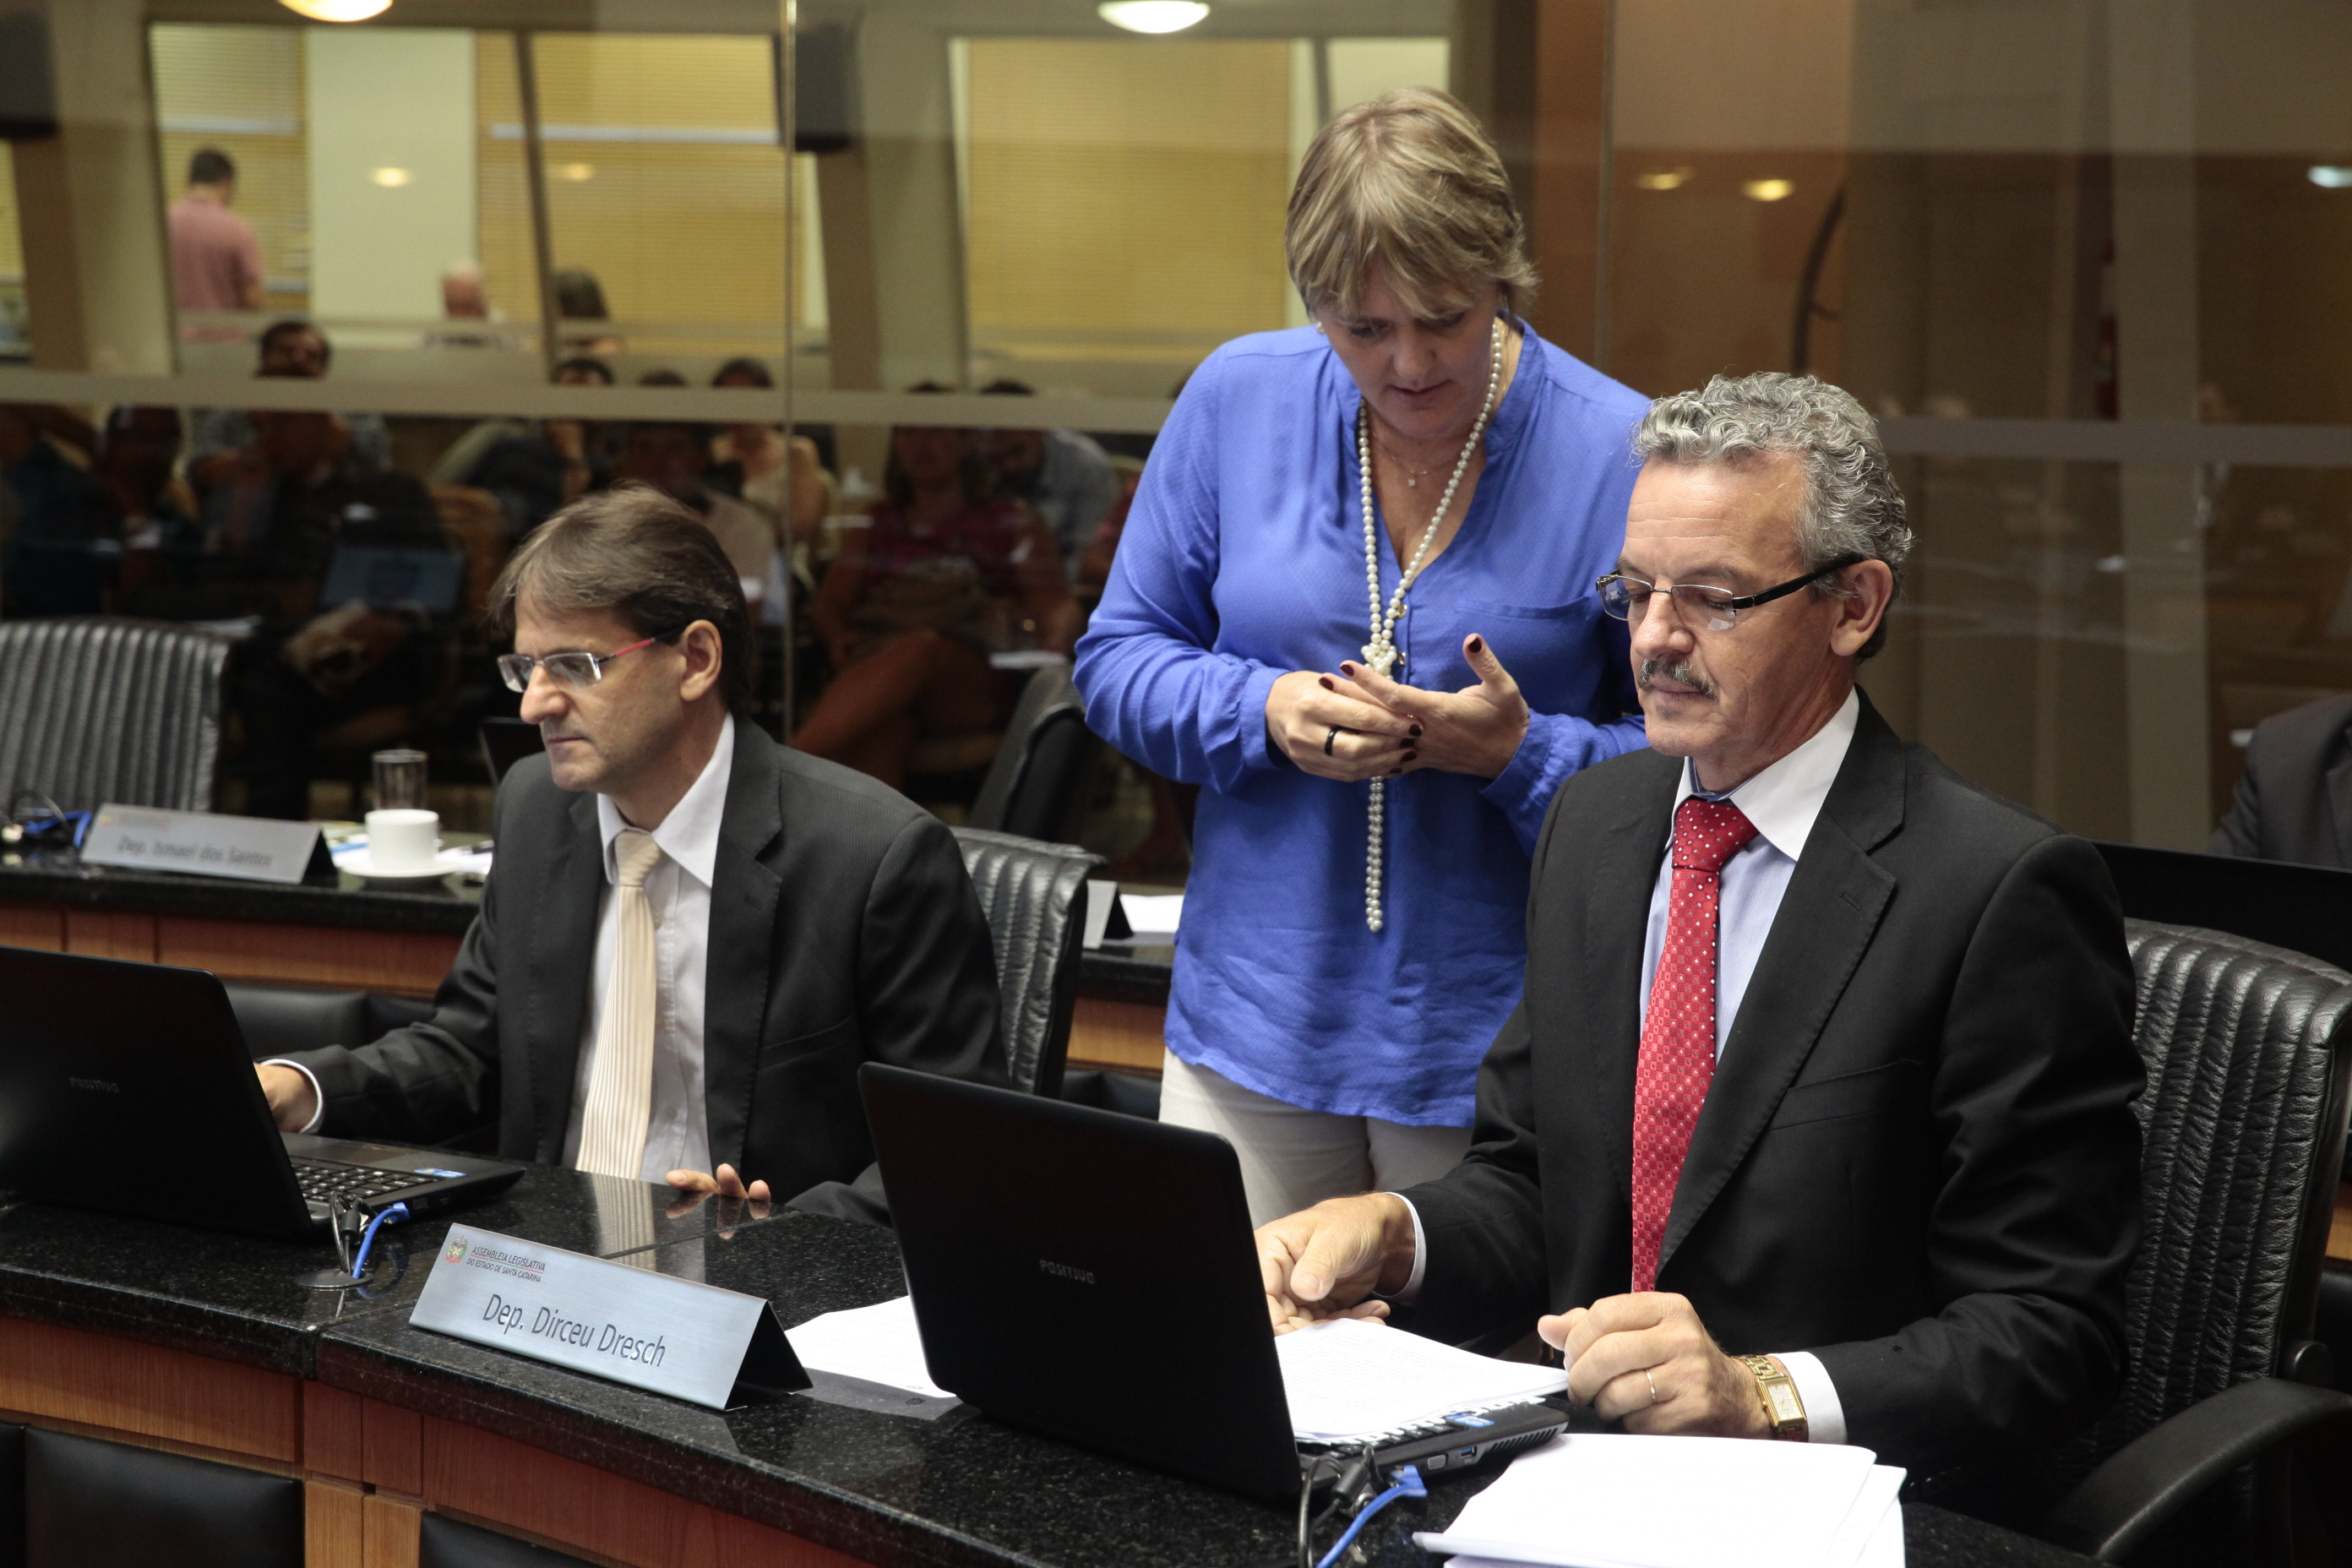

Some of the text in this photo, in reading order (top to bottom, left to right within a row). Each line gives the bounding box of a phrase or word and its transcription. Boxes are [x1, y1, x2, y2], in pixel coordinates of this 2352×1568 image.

[471, 1246, 546, 1271] ASSEMBLEIA LEGISLATIVA
[475, 1260, 494, 1271] ESTADO
[501, 1267, 517, 1277] SANTA
[517, 1271, 542, 1282] CATARINA
[482, 1293, 666, 1367] Dep. Dirceu Dresch
